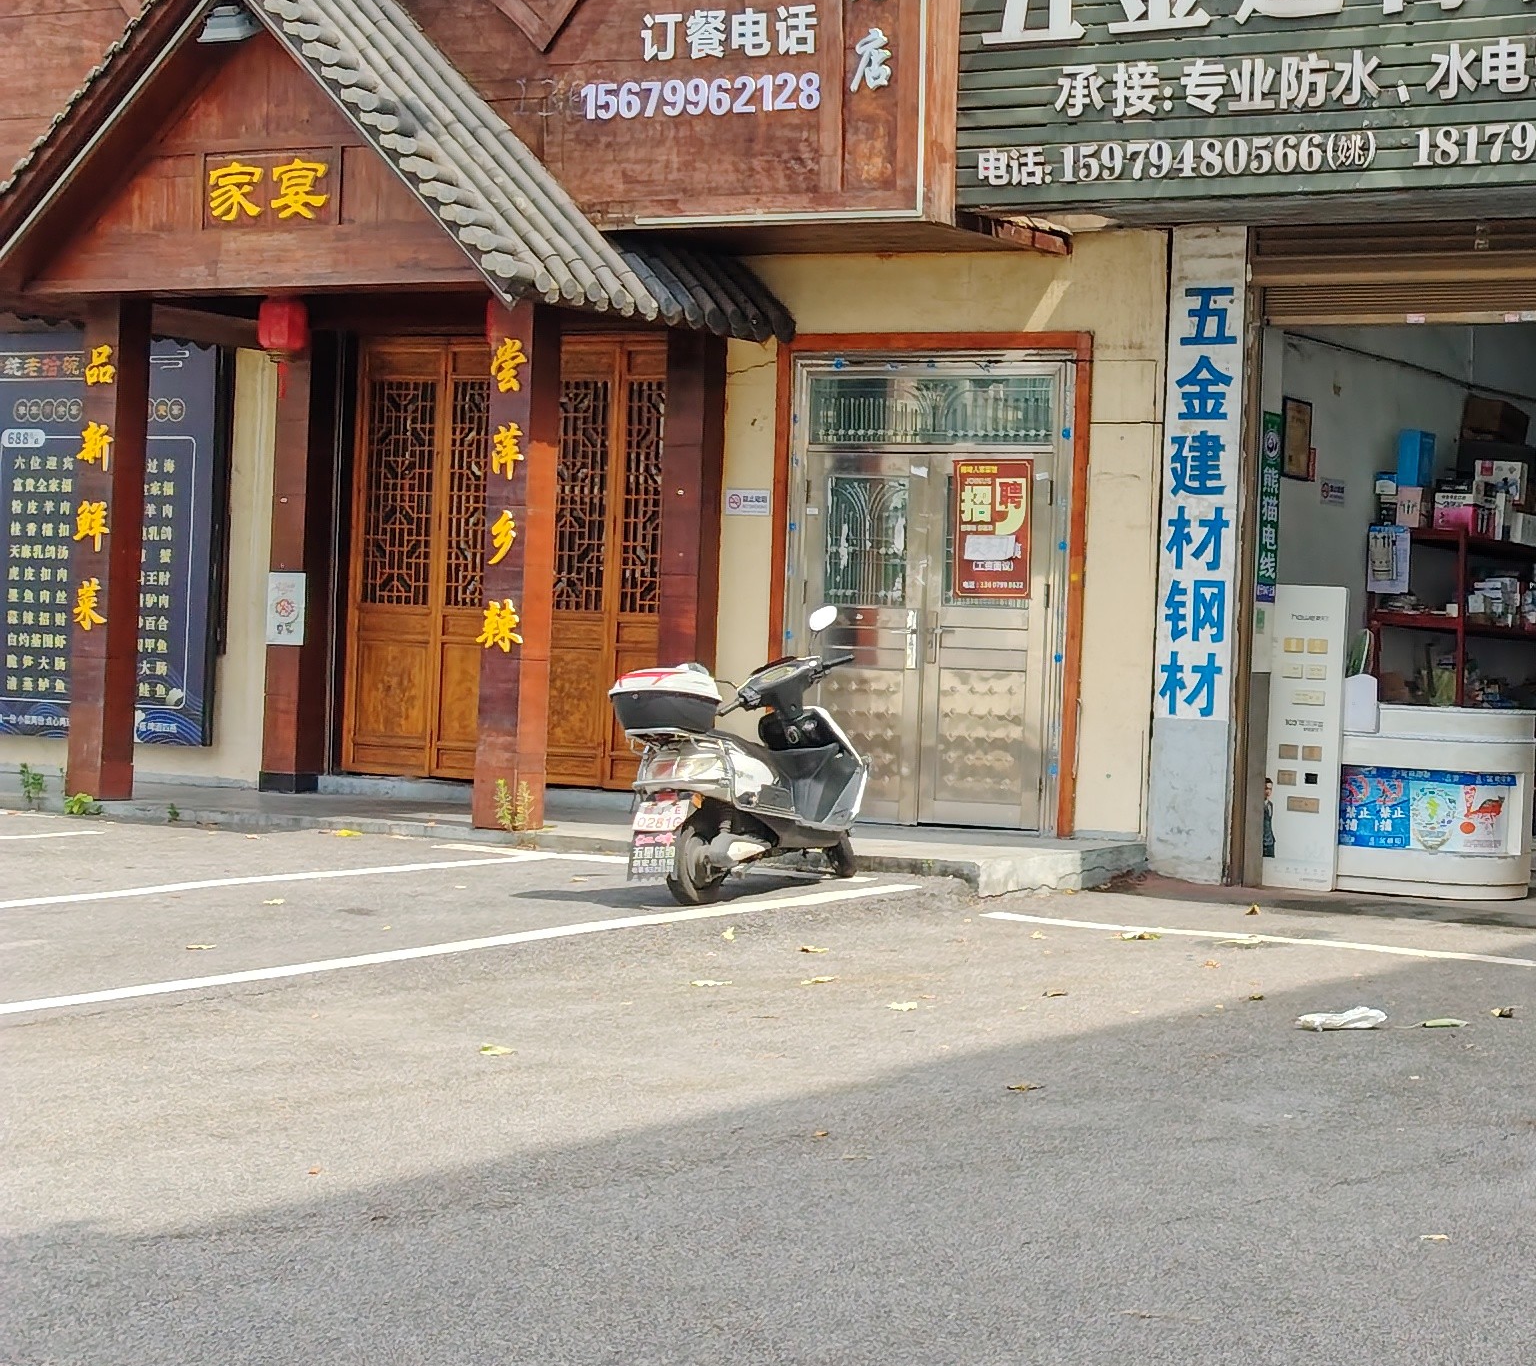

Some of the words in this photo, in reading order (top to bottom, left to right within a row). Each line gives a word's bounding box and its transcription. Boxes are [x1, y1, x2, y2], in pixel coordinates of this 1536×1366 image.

[640, 4, 818, 62] 订餐电话
[580, 71, 821, 120] 15679962128
[207, 157, 330, 221] 家宴
[0, 355, 80, 378] 统老拾碗
[72, 344, 117, 631] 品新鲜菜
[1159, 285, 1239, 718] 五金建材钢材
[1258, 465, 1282, 580] 熊猫电线
